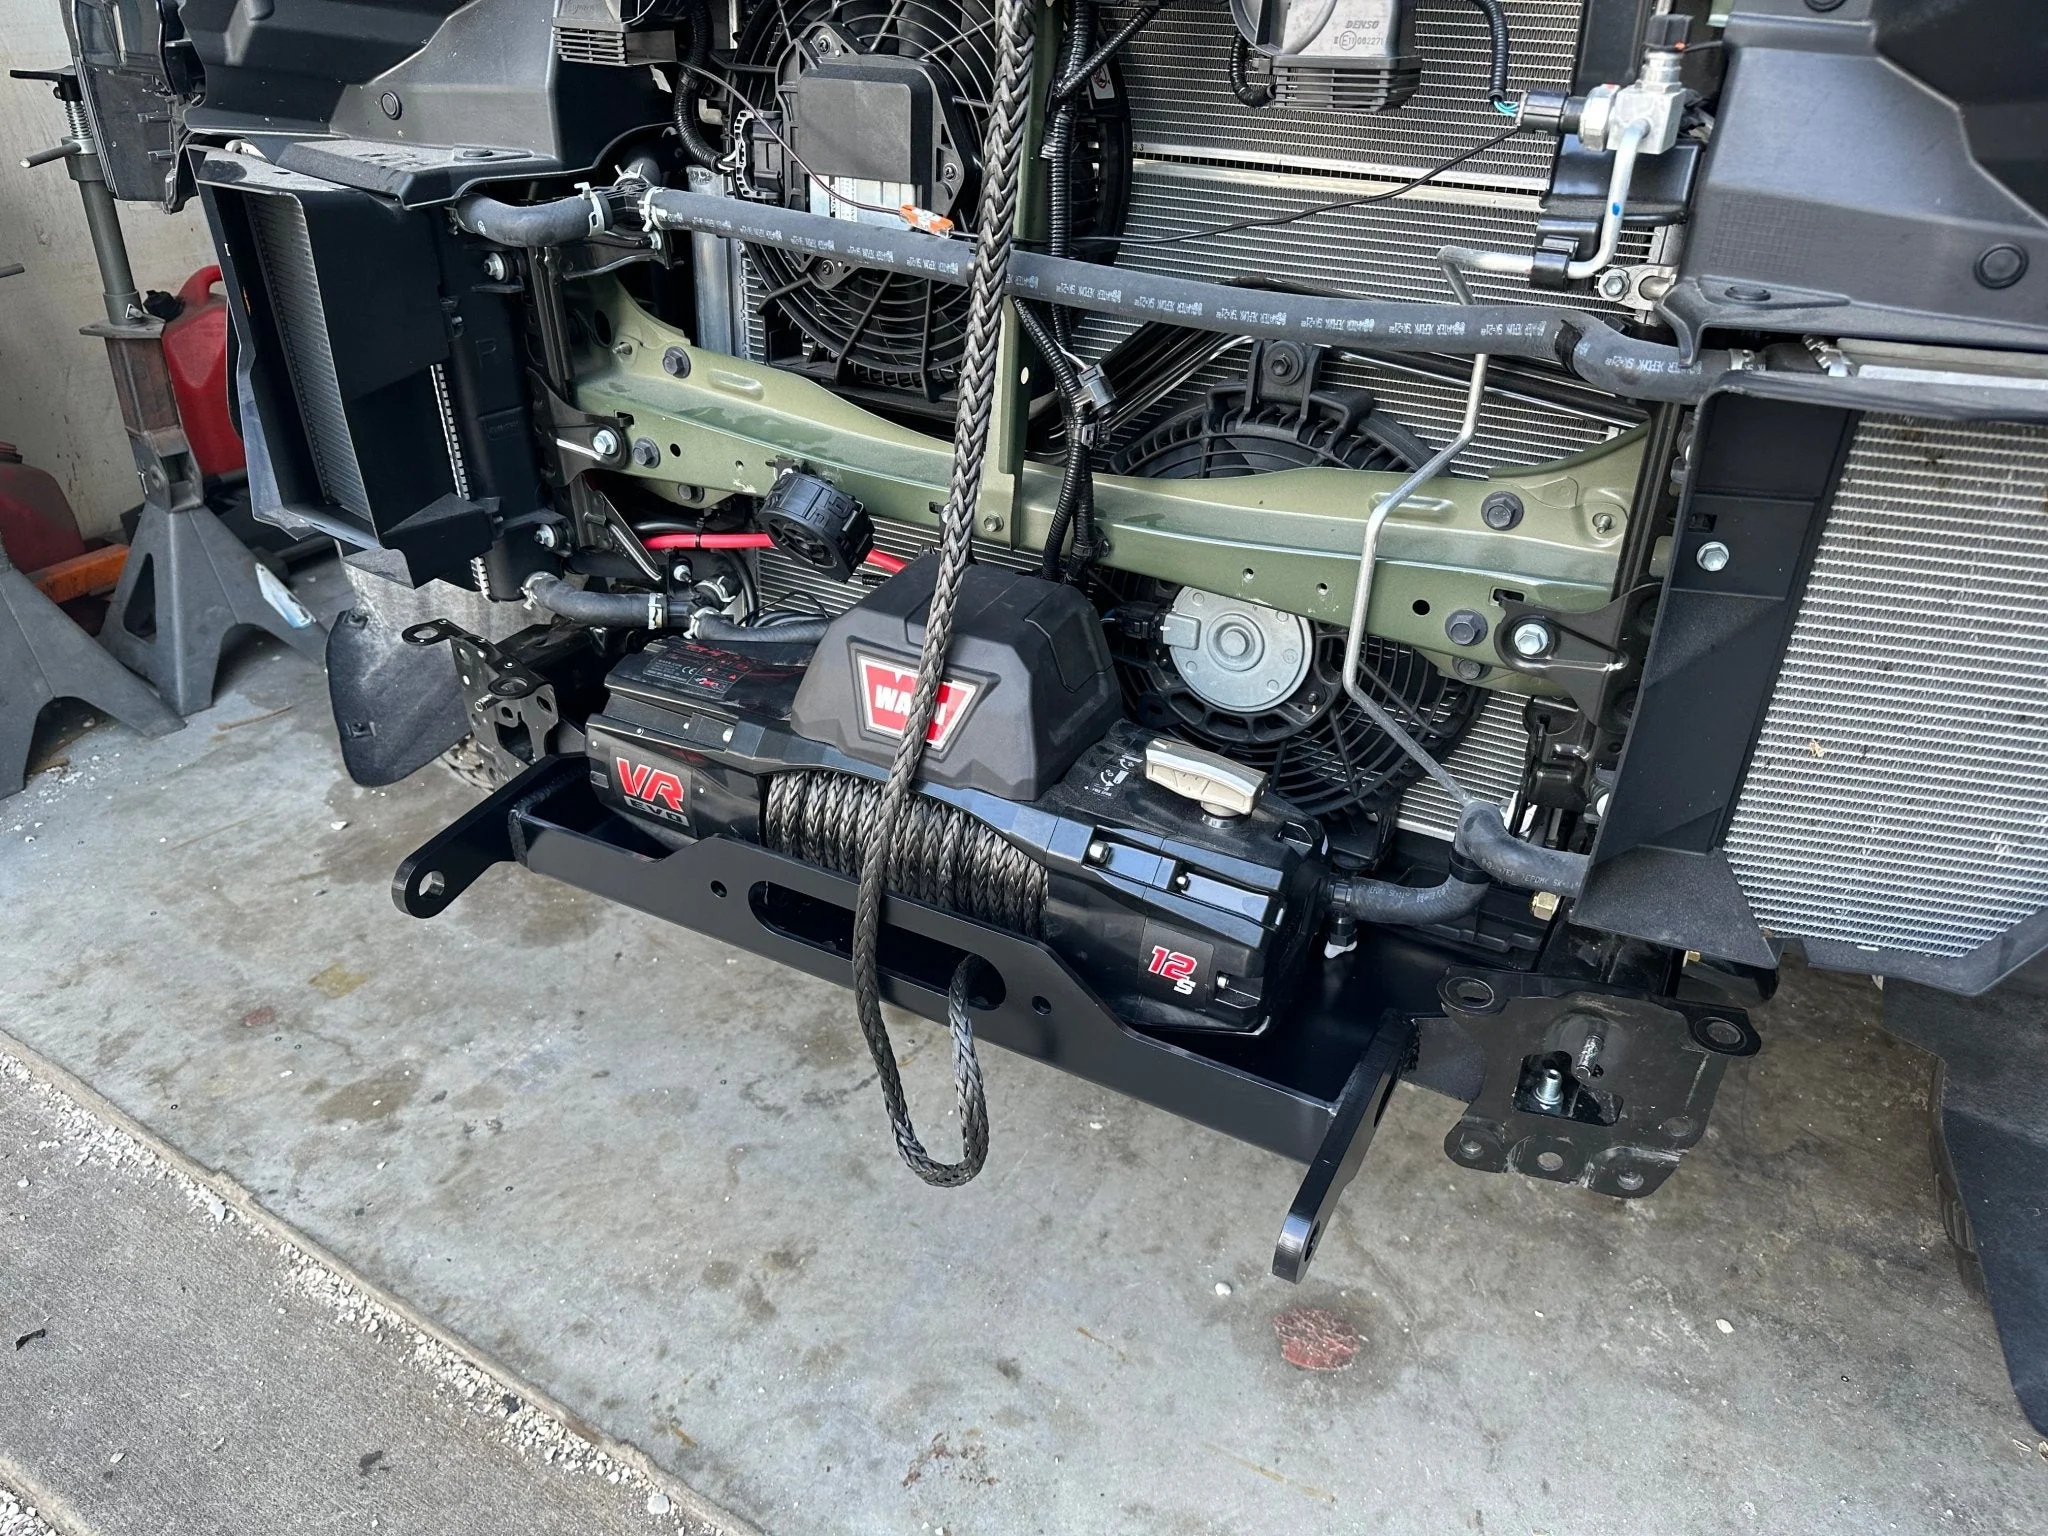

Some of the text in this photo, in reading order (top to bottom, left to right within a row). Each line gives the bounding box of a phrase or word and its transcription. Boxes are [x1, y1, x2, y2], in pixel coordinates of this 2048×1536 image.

[1345, 20, 1380, 30] DENSO
[616, 756, 684, 813] VR
[629, 799, 683, 823] EVO
[1147, 944, 1198, 982] 12
